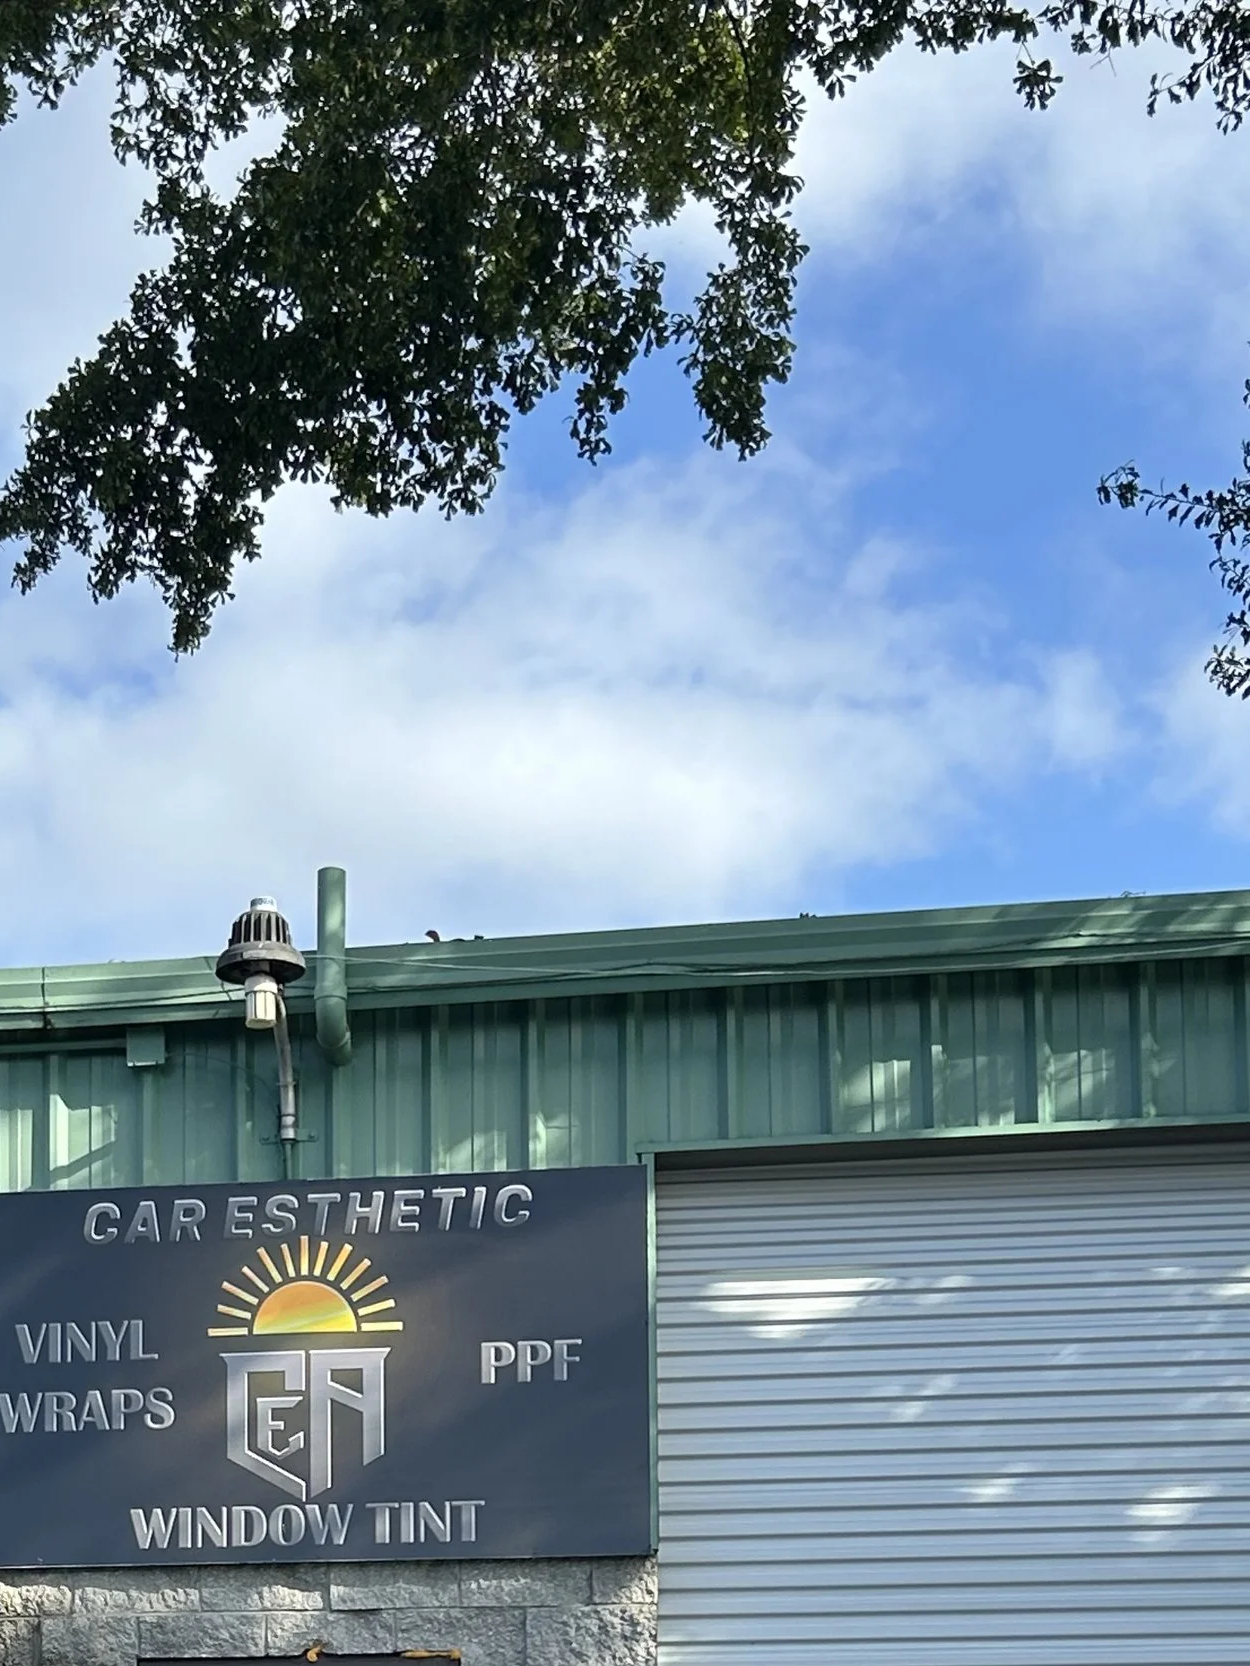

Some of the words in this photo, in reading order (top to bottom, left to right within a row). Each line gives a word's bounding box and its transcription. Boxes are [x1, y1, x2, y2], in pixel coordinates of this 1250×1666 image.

[83, 1198, 206, 1245] CAR
[223, 1184, 533, 1240] ESTHETIC
[15, 1319, 159, 1364] VINYL
[480, 1339, 583, 1384] PPF
[130, 1503, 352, 1550] WINDOW
[365, 1500, 485, 1544] TINT
